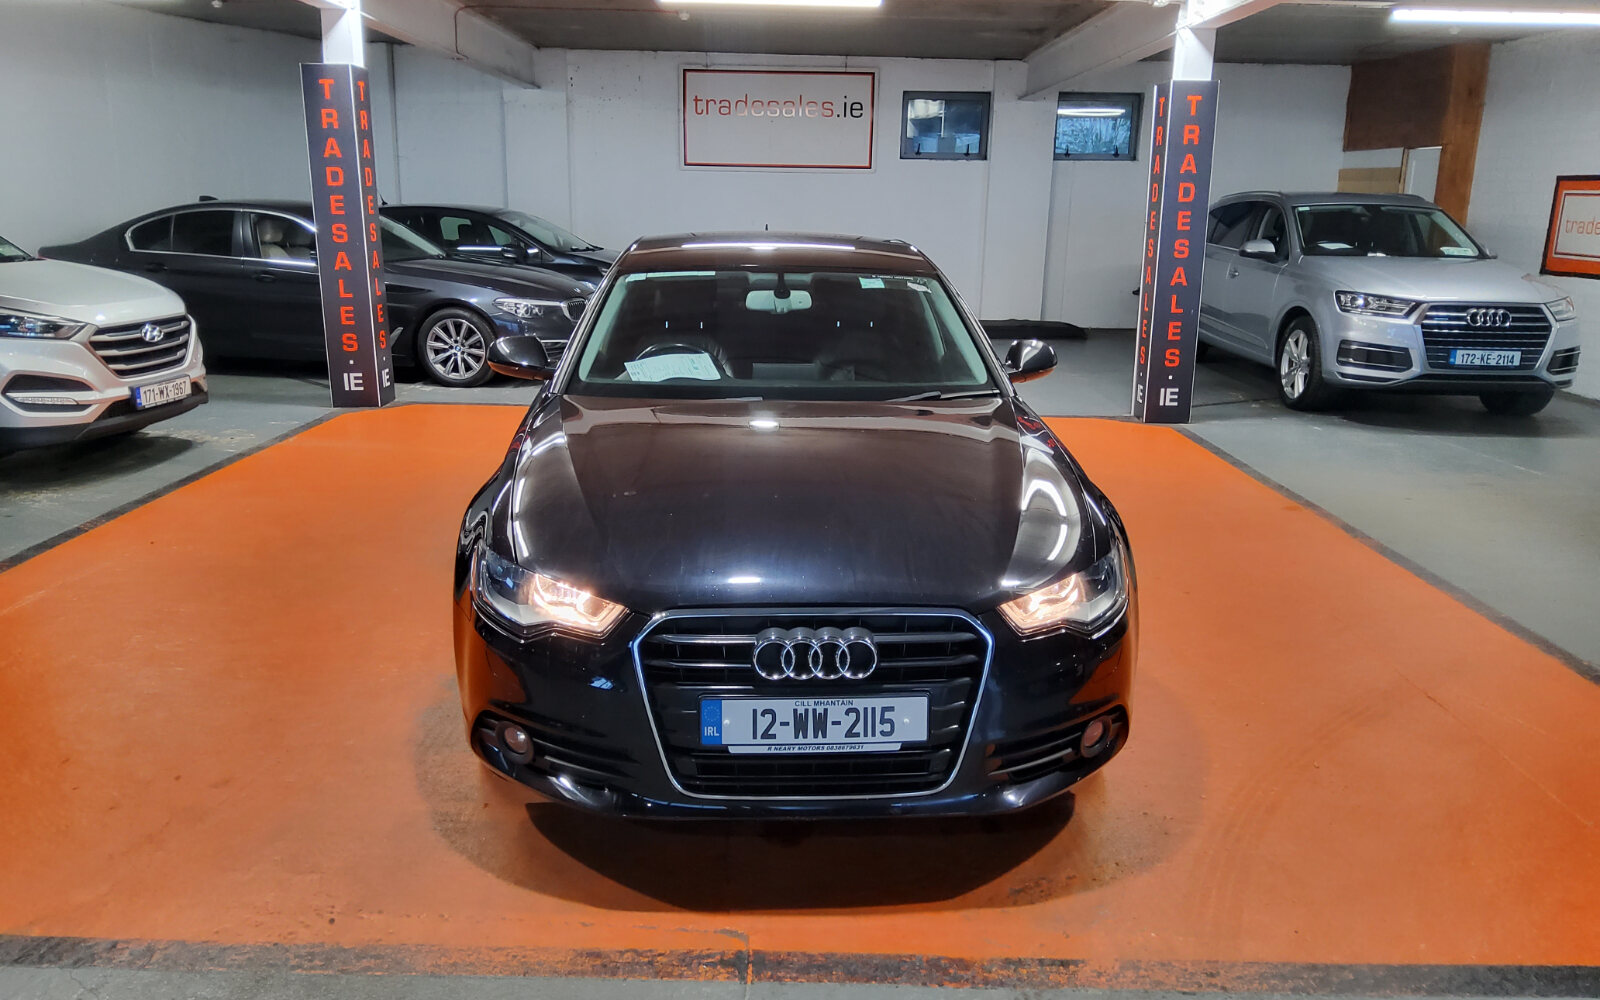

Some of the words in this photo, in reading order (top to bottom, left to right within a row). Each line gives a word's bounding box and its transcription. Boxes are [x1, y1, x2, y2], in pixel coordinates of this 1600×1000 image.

[693, 93, 864, 119] tradesales.ie
[1461, 353, 1515, 365] 172-KE-2114
[143, 381, 187, 404] 171-WX-1967
[704, 727, 720, 737] IRL
[752, 706, 896, 740] 12-WW-2115
